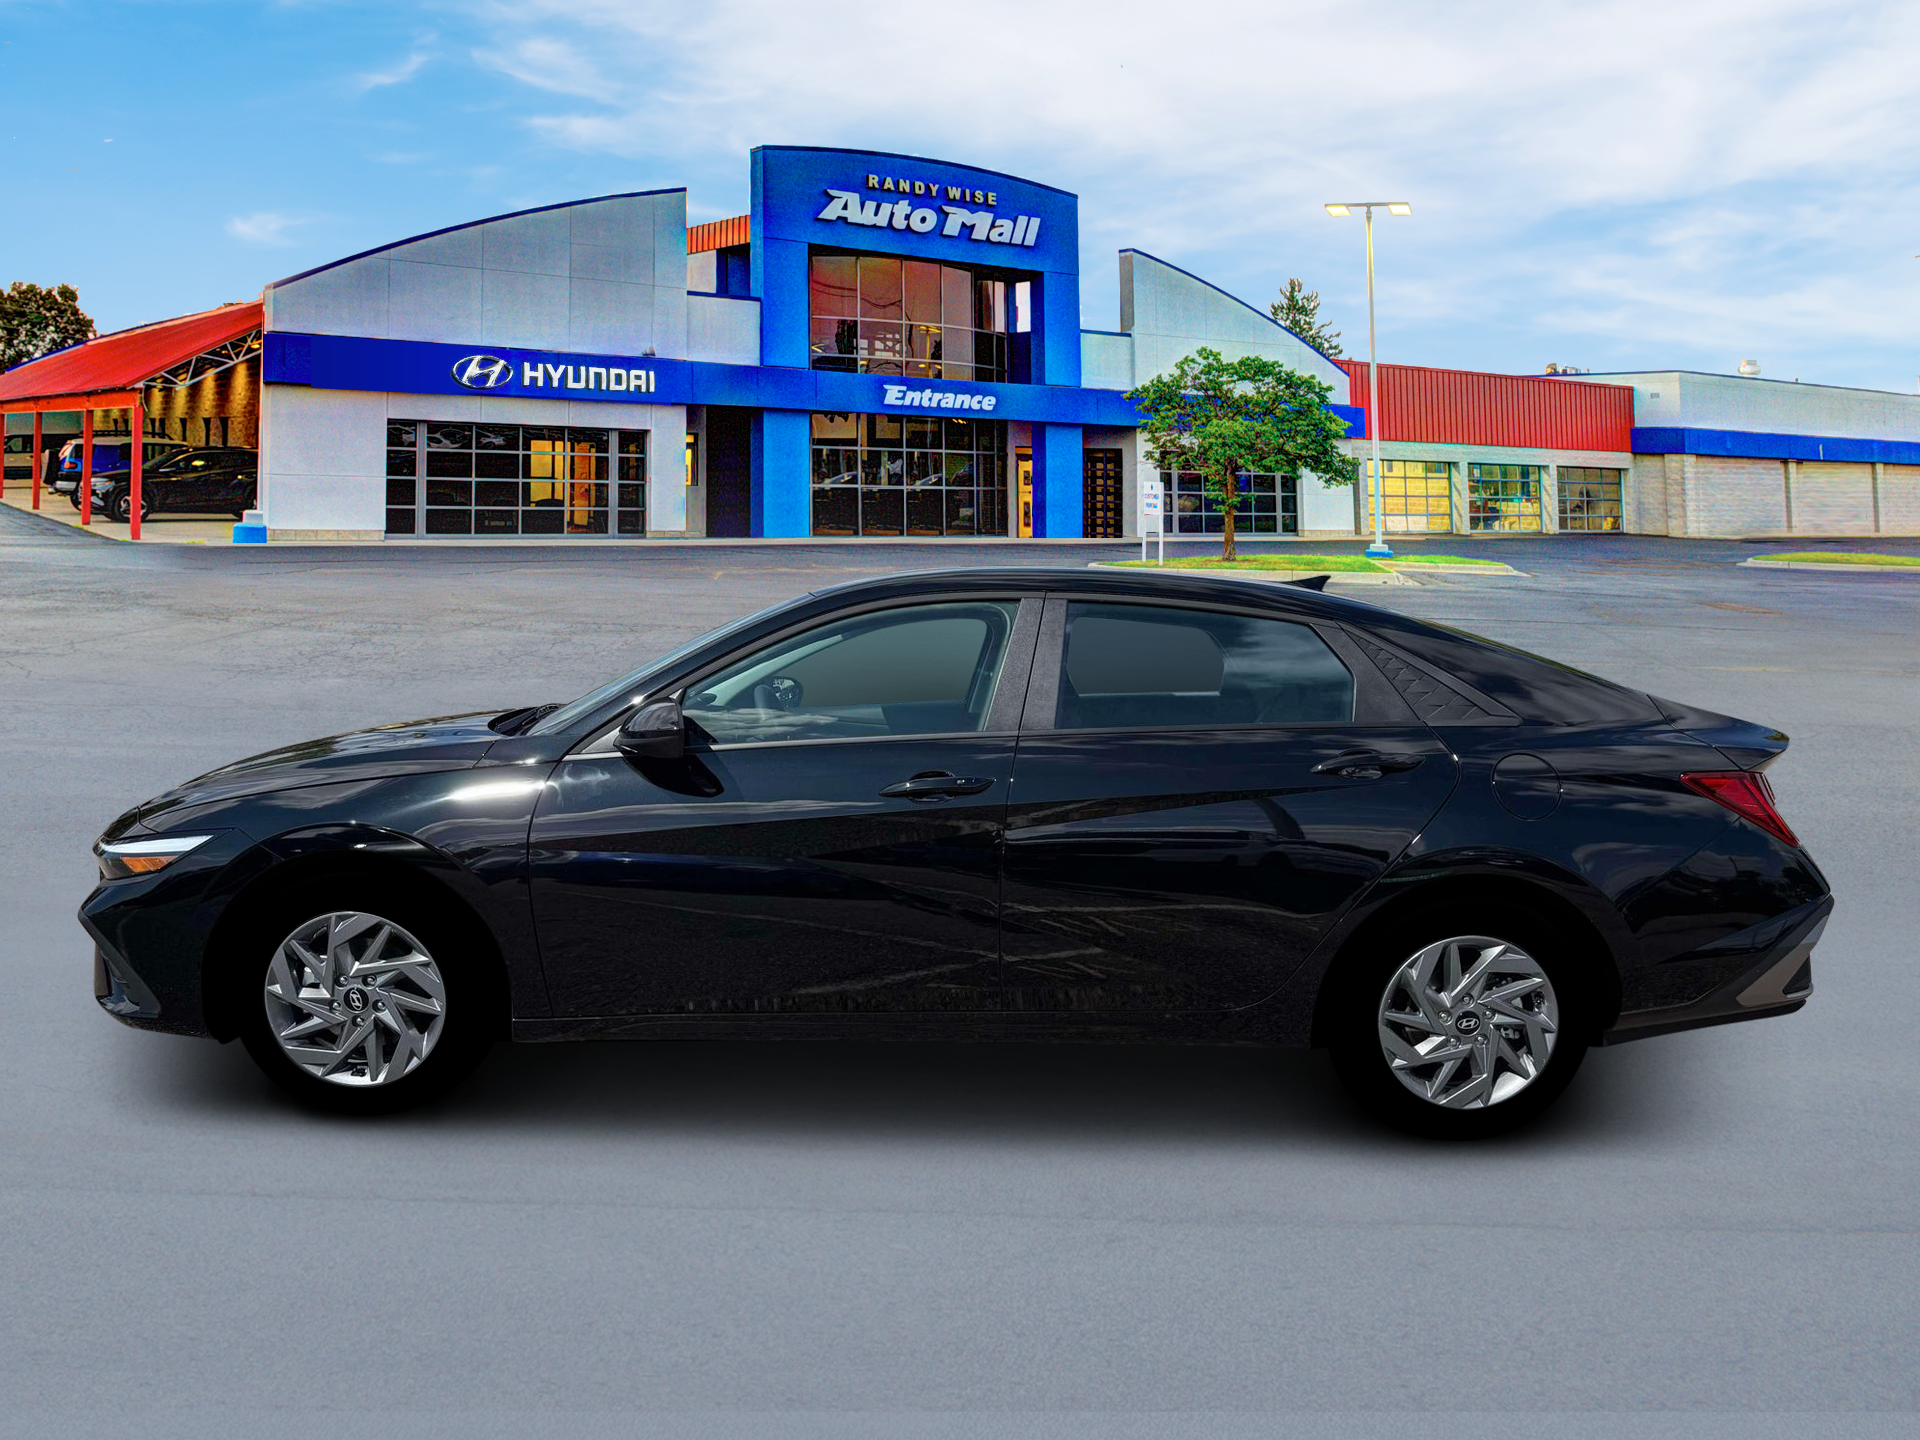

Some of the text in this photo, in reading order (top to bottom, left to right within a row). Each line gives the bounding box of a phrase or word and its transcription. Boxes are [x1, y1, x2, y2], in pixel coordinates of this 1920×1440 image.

[867, 174, 997, 205] RANDY WISE
[817, 188, 1041, 247] Auto Mall
[521, 361, 655, 393] HYUNDAI
[883, 384, 997, 411] Entrance
